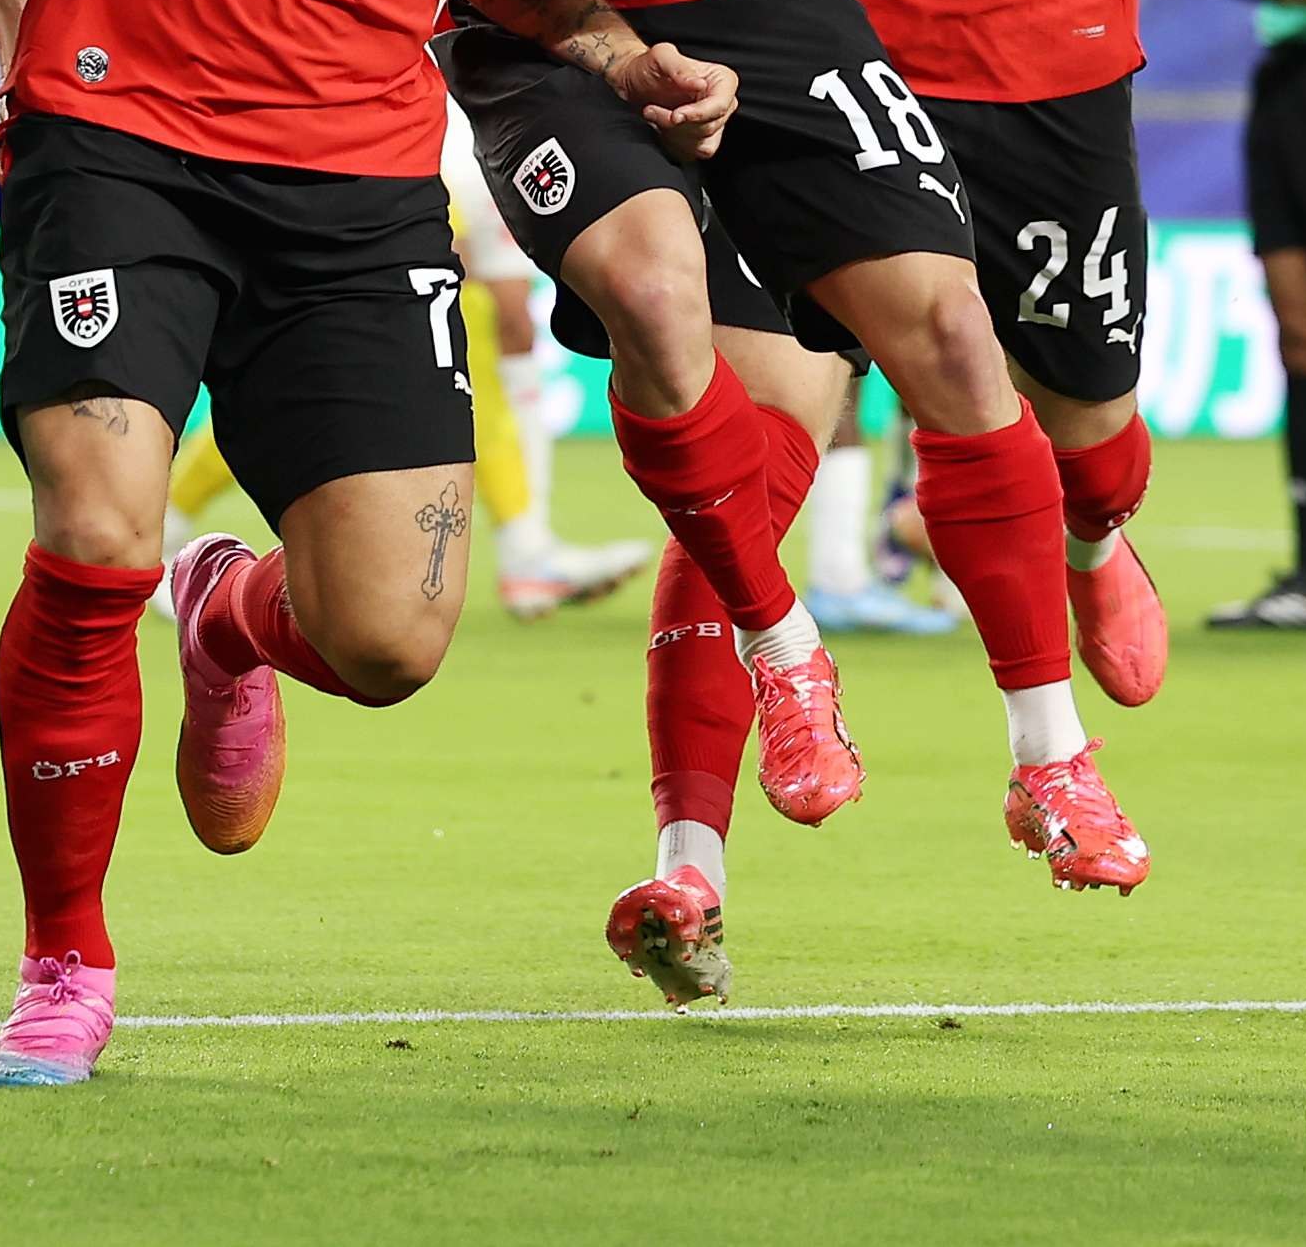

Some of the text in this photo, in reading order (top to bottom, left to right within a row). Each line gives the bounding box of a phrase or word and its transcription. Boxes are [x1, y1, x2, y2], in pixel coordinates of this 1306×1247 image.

[808, 60, 945, 171] 18
[408, 268, 461, 368] 7
[1016, 205, 1132, 330] 24
[32, 749, 121, 781] ÖFB
